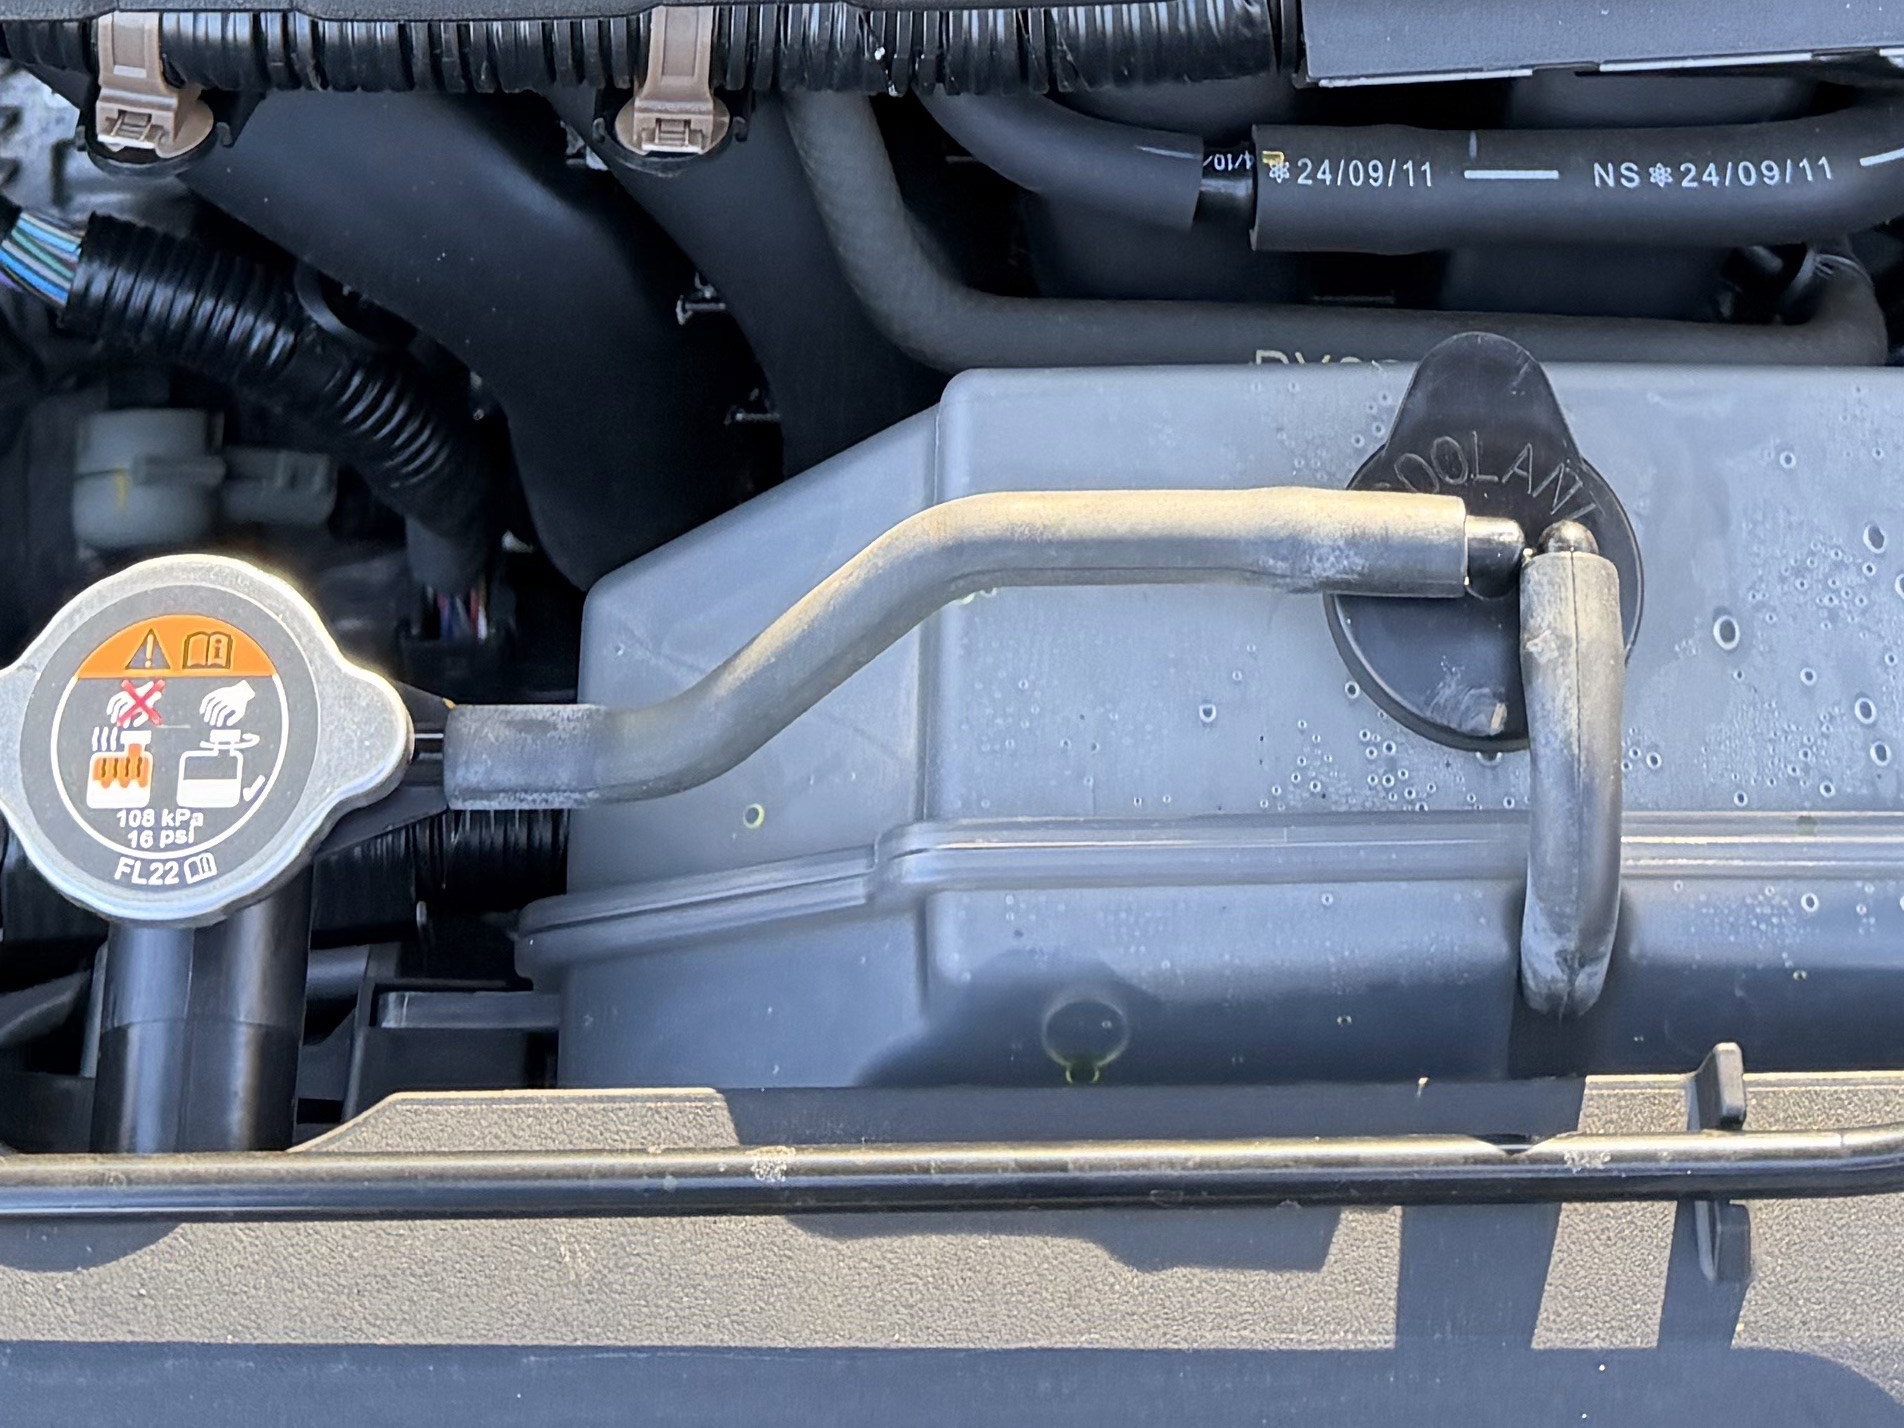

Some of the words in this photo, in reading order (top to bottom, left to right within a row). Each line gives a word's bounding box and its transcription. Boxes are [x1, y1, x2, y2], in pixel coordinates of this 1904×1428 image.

[1296, 147, 1433, 188] 24/09/11
[1679, 156, 1835, 189] 24/09/11
[116, 808, 156, 828] 108
[161, 808, 205, 828] kPa
[127, 829, 154, 849] 16
[114, 856, 180, 886] FL22
